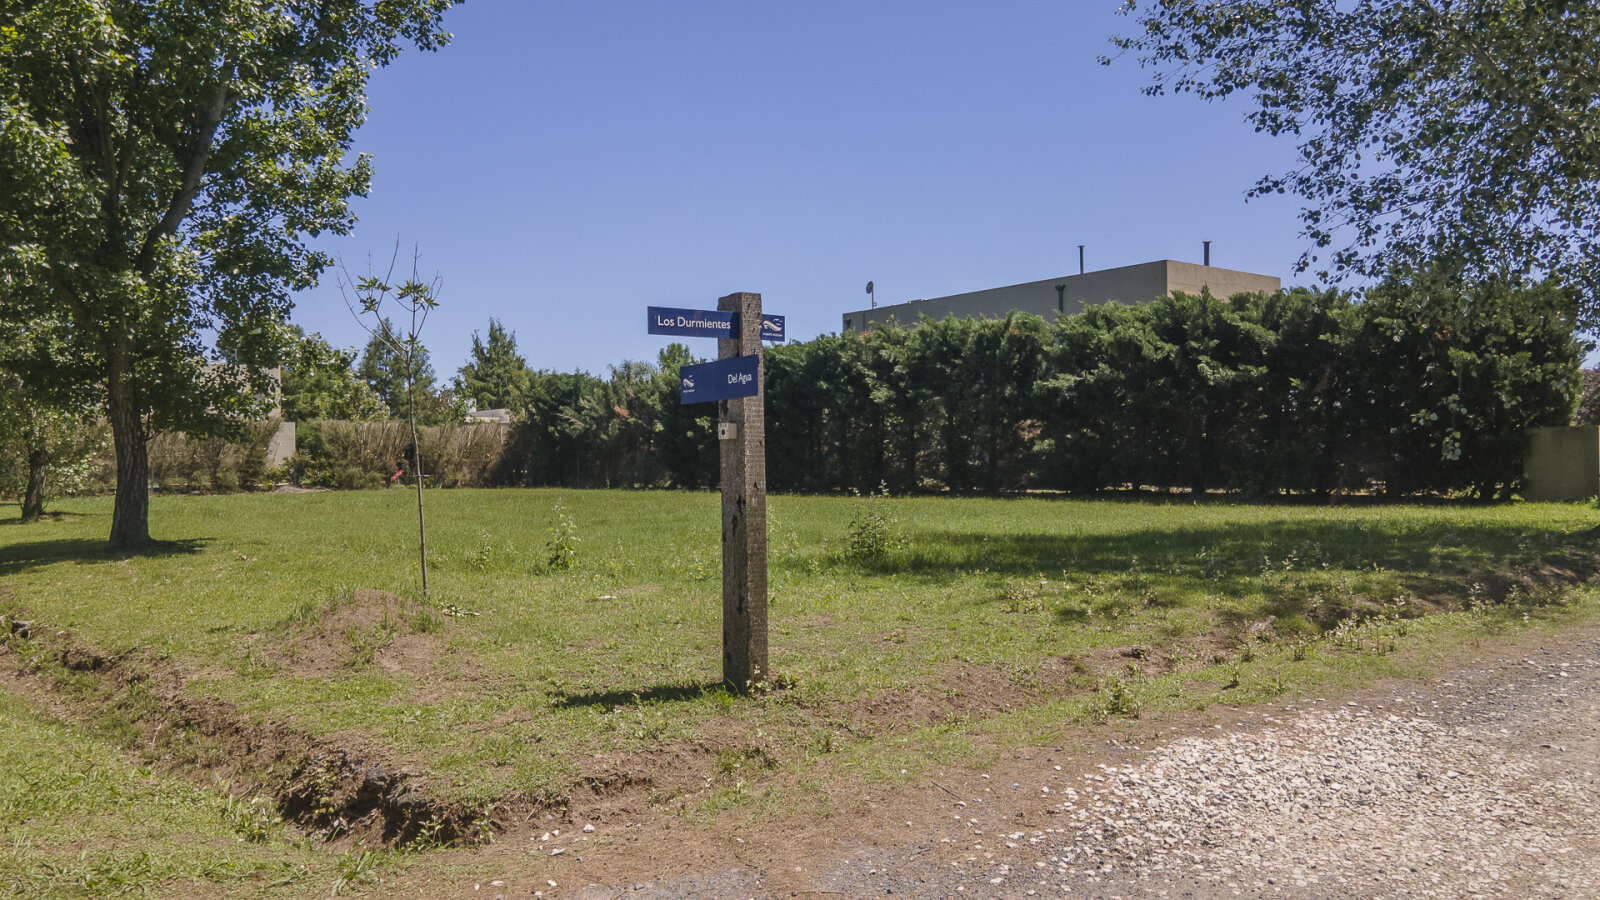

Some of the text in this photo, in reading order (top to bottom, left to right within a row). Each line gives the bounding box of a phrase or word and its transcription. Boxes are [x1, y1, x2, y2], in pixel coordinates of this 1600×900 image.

[657, 315, 731, 330] Los Durmientes
[727, 373, 752, 385] Del Agua
